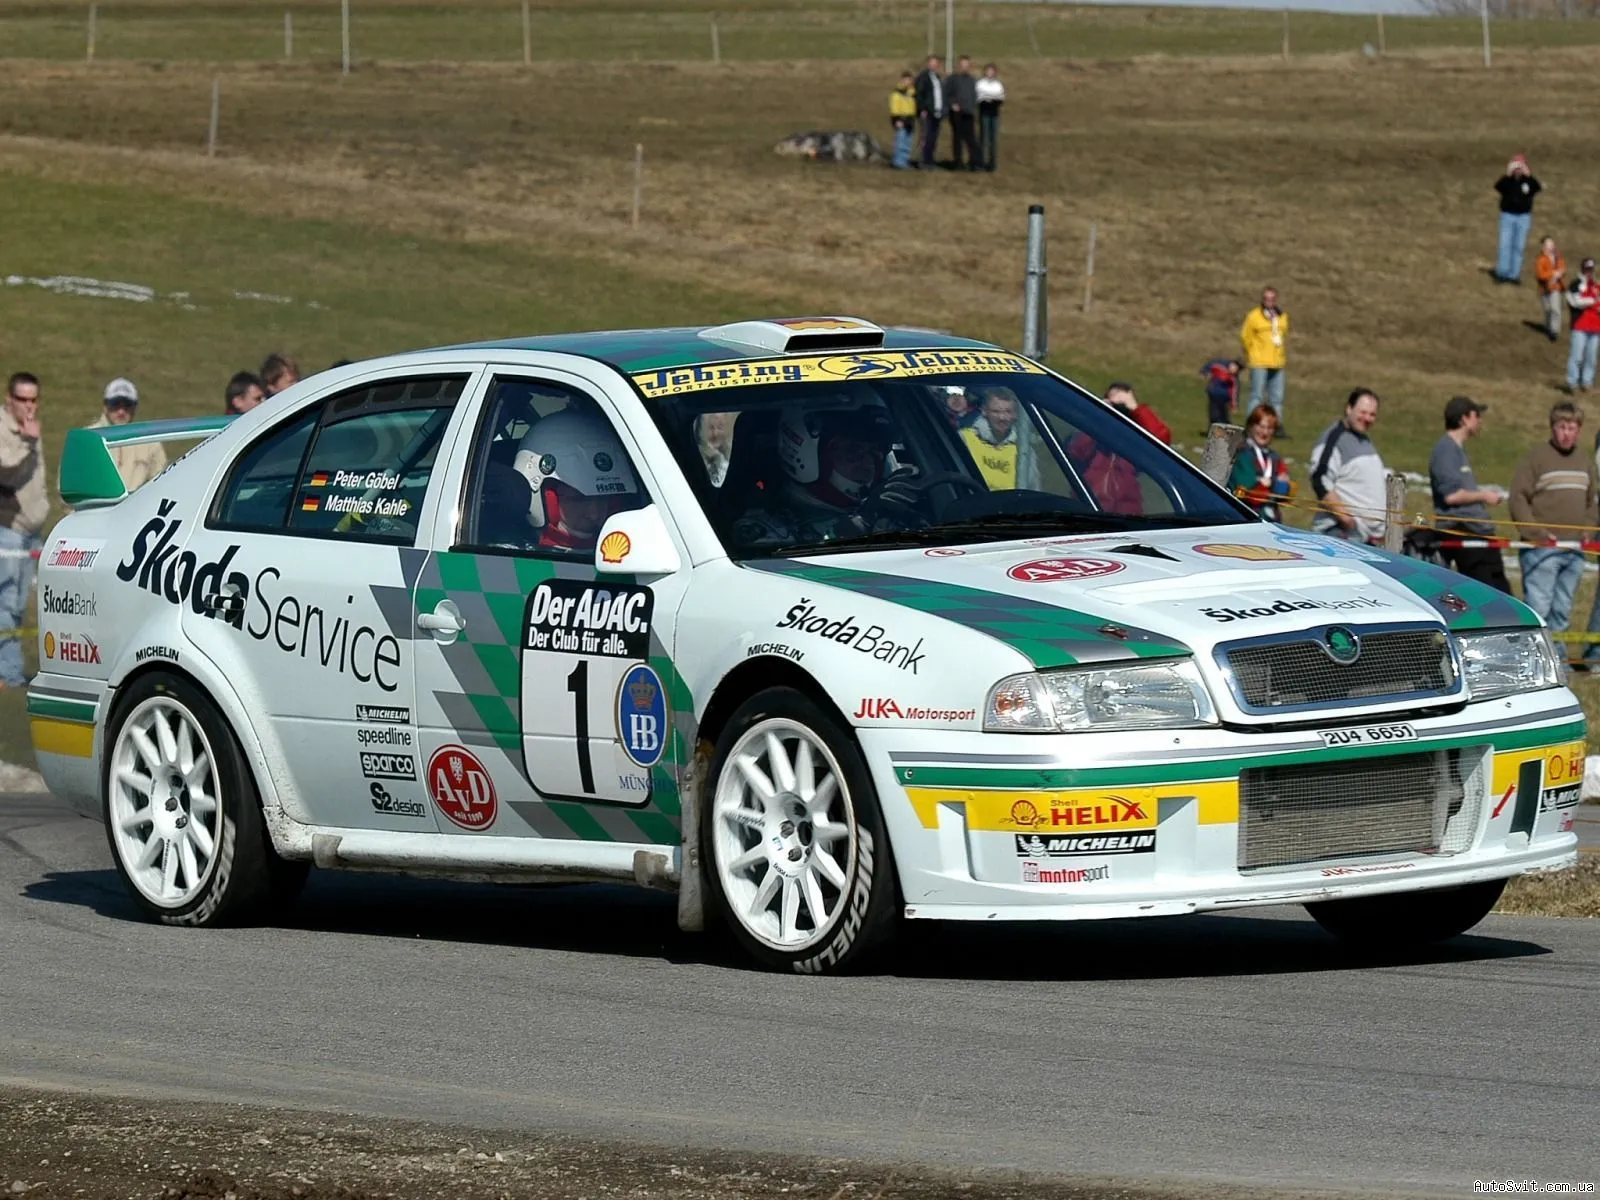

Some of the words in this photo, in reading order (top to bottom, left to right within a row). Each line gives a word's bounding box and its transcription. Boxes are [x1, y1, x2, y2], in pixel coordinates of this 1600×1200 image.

[650, 376, 781, 397] SPORTAUSPUFF
[333, 470, 365, 488] Peter
[365, 472, 400, 490] Göbel
[325, 495, 373, 514] Matthias
[374, 498, 408, 516] Kahle
[530, 584, 576, 627] Der
[572, 588, 648, 634] ADAC.
[528, 626, 550, 648] Der
[552, 628, 579, 651] Club
[582, 632, 601, 654] für
[602, 634, 629, 655] alle.
[60, 641, 102, 664] HELIX
[136, 646, 179, 662] MICHELIN
[747, 642, 805, 662] MICHELIN
[368, 708, 409, 720] MICHELIN
[905, 707, 976, 722] Motorsport
[357, 727, 411, 747] speedline
[567, 660, 597, 794] 1
[629, 713, 658, 751] HB
[1324, 730, 1362, 745] 2U4
[1366, 725, 1413, 740] 6651
[362, 754, 413, 776] sparco
[1050, 799, 1078, 807] Shell
[1050, 799, 1148, 826] HELIX
[1047, 835, 1155, 851] MICHELIN
[793, 823, 874, 974] MICHELIN
